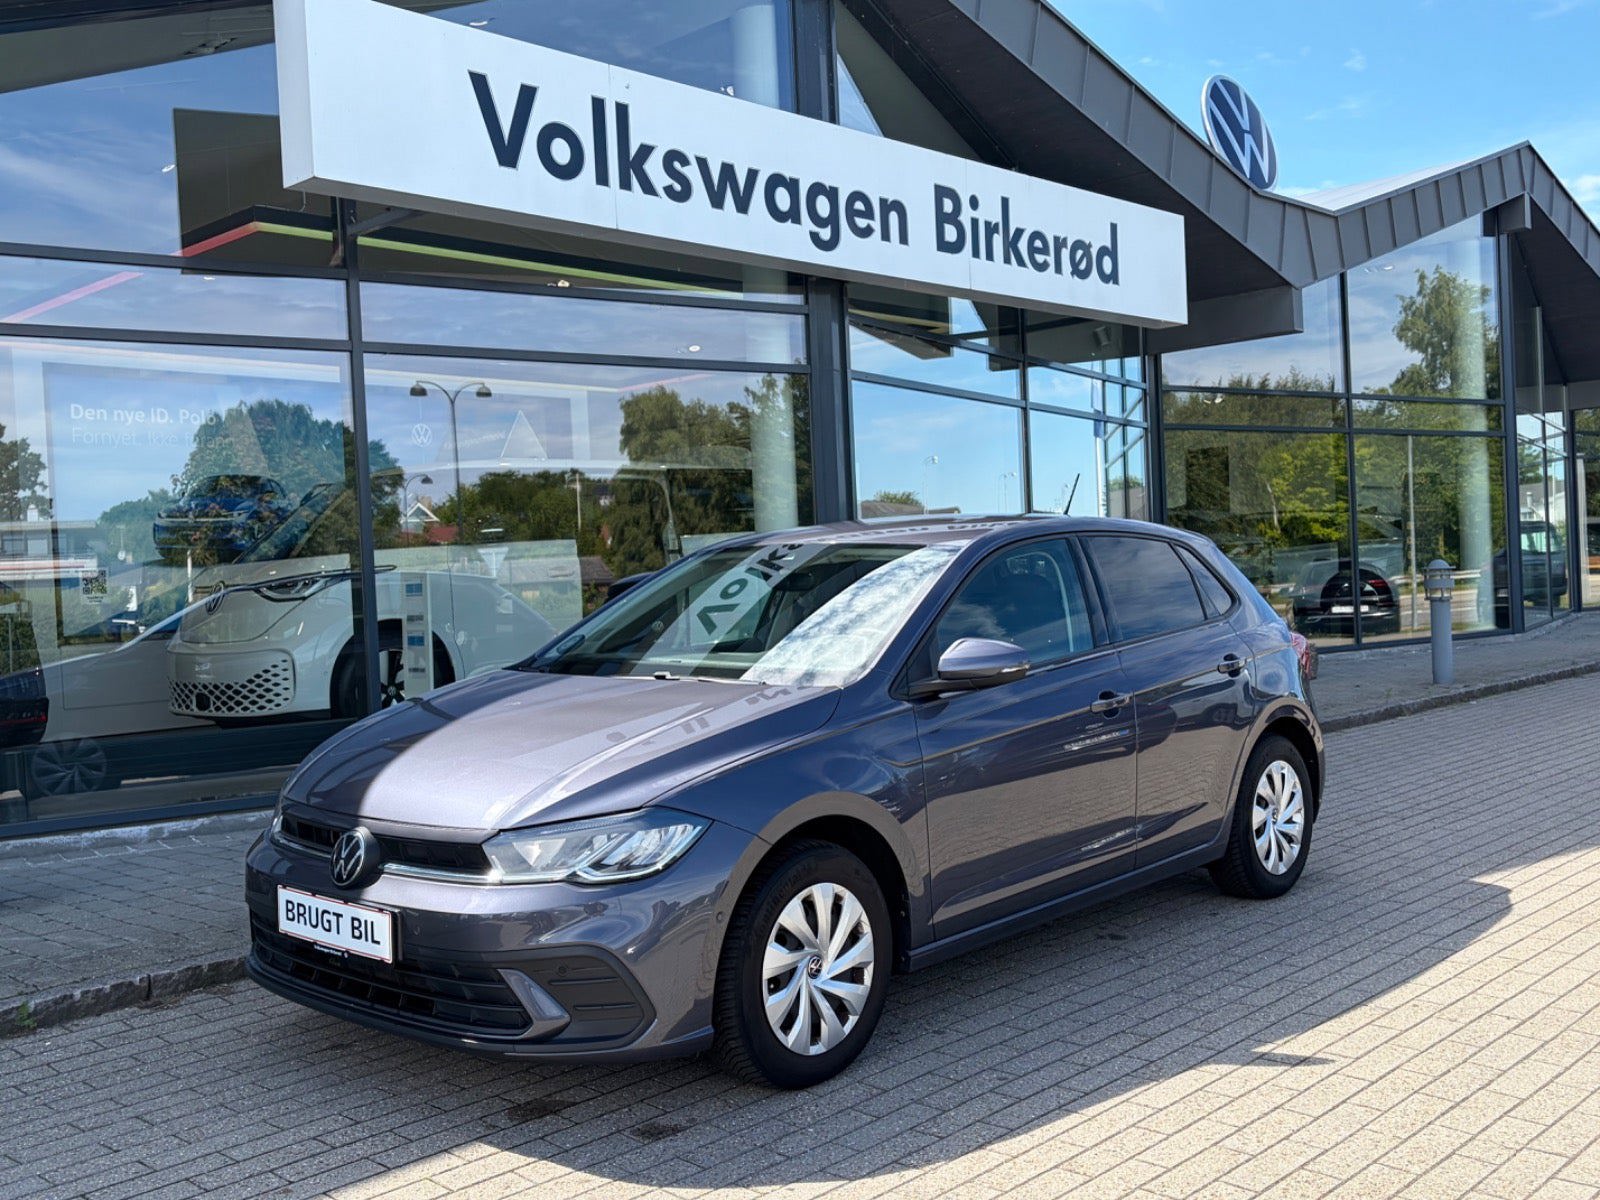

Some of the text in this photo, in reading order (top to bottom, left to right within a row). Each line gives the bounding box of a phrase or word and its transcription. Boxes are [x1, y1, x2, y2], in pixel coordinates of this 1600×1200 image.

[467, 69, 1120, 286] Volkswagen Birkerød
[70, 403, 217, 426] Den nye ID. Polo
[285, 898, 382, 946] BRUGT BIL
